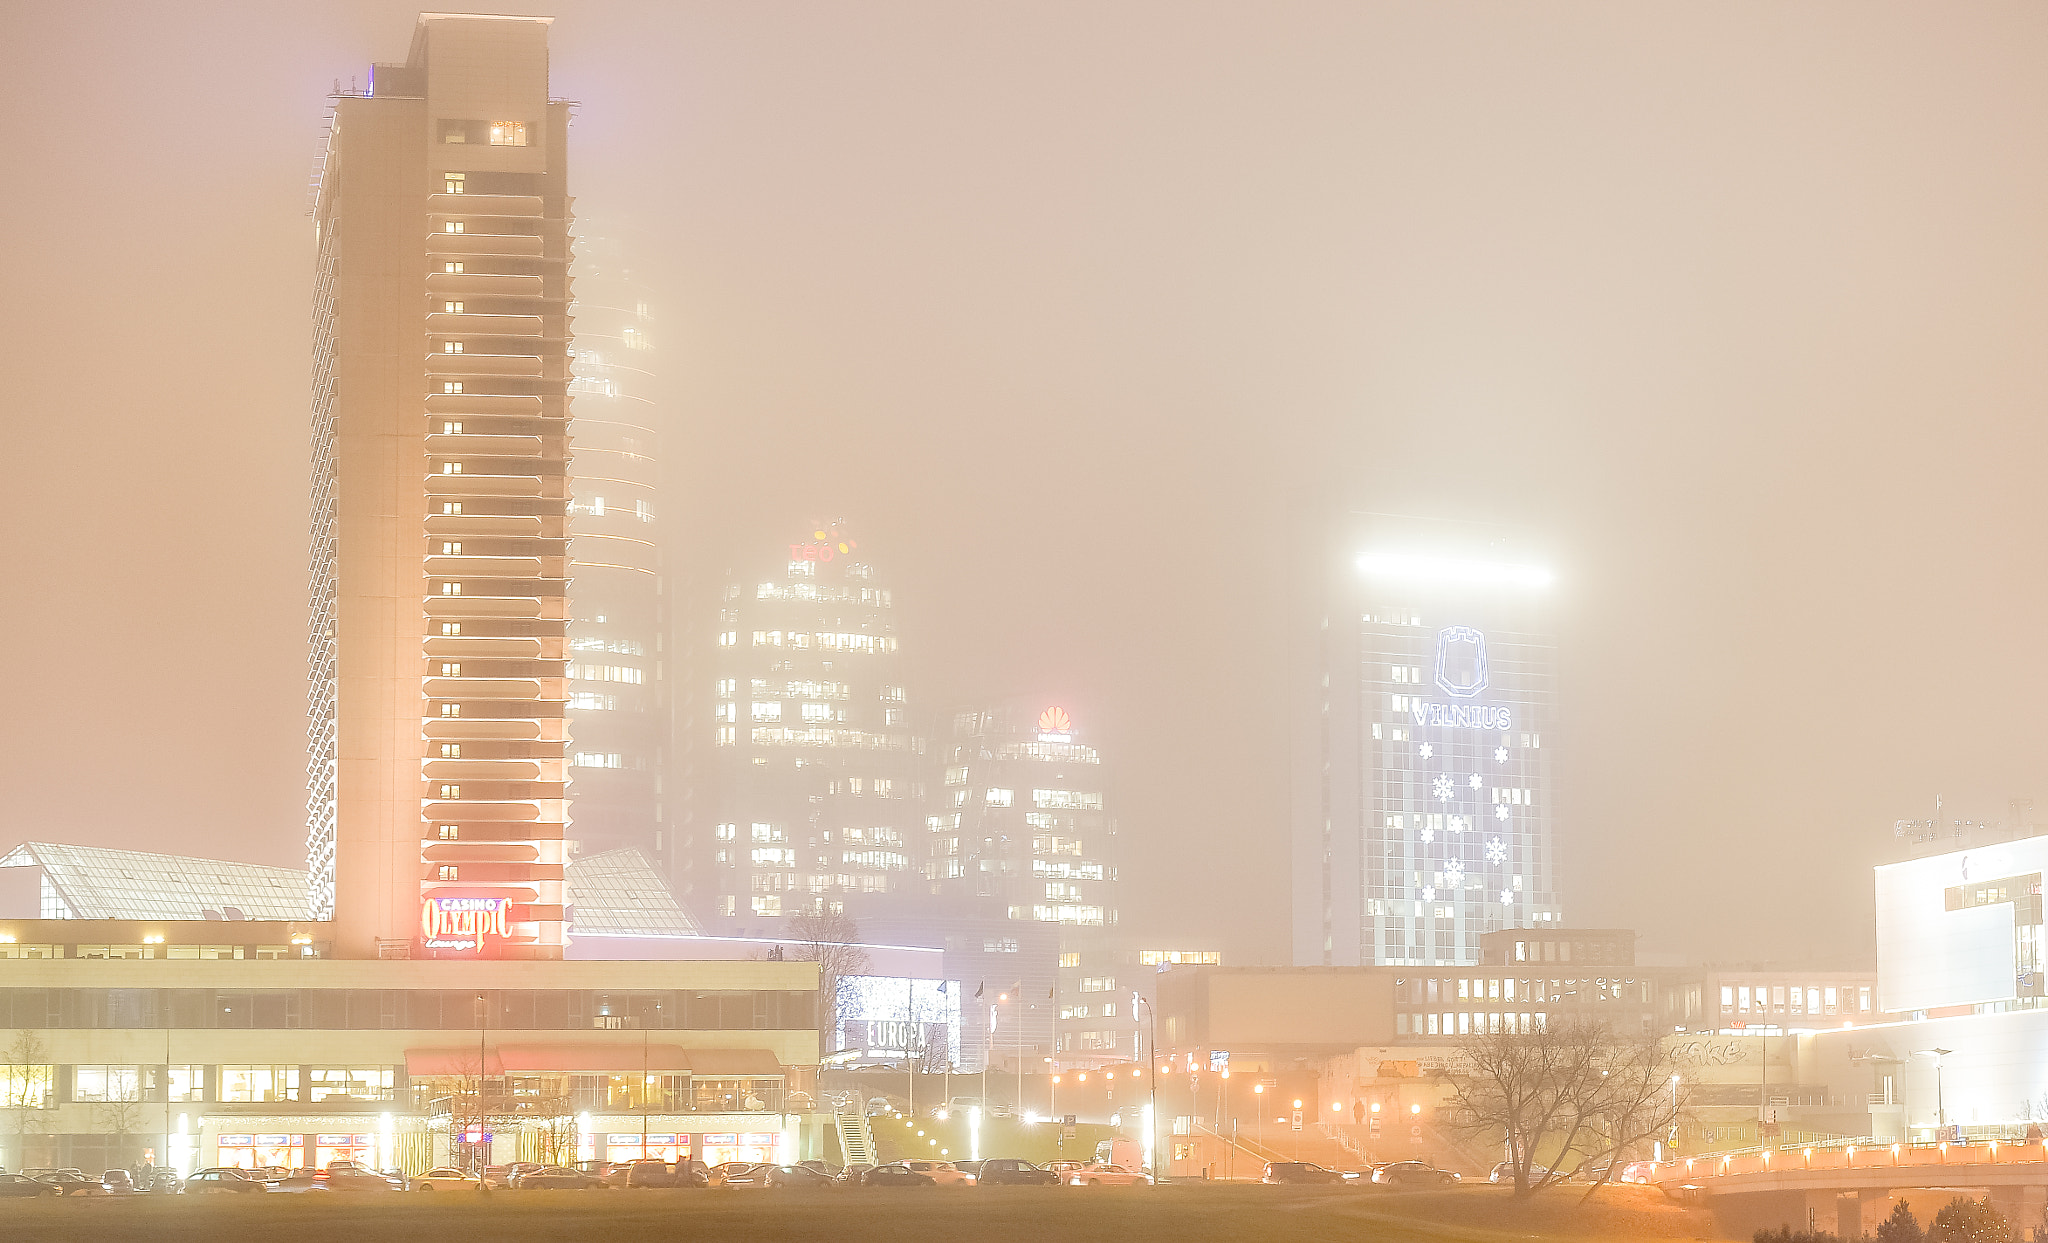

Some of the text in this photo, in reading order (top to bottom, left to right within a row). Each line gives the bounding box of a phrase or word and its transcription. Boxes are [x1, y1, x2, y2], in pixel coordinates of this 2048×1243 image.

[1411, 702, 1512, 731] VILNIUS
[440, 898, 498, 911] CASINO
[866, 1021, 926, 1048] EUROPA
